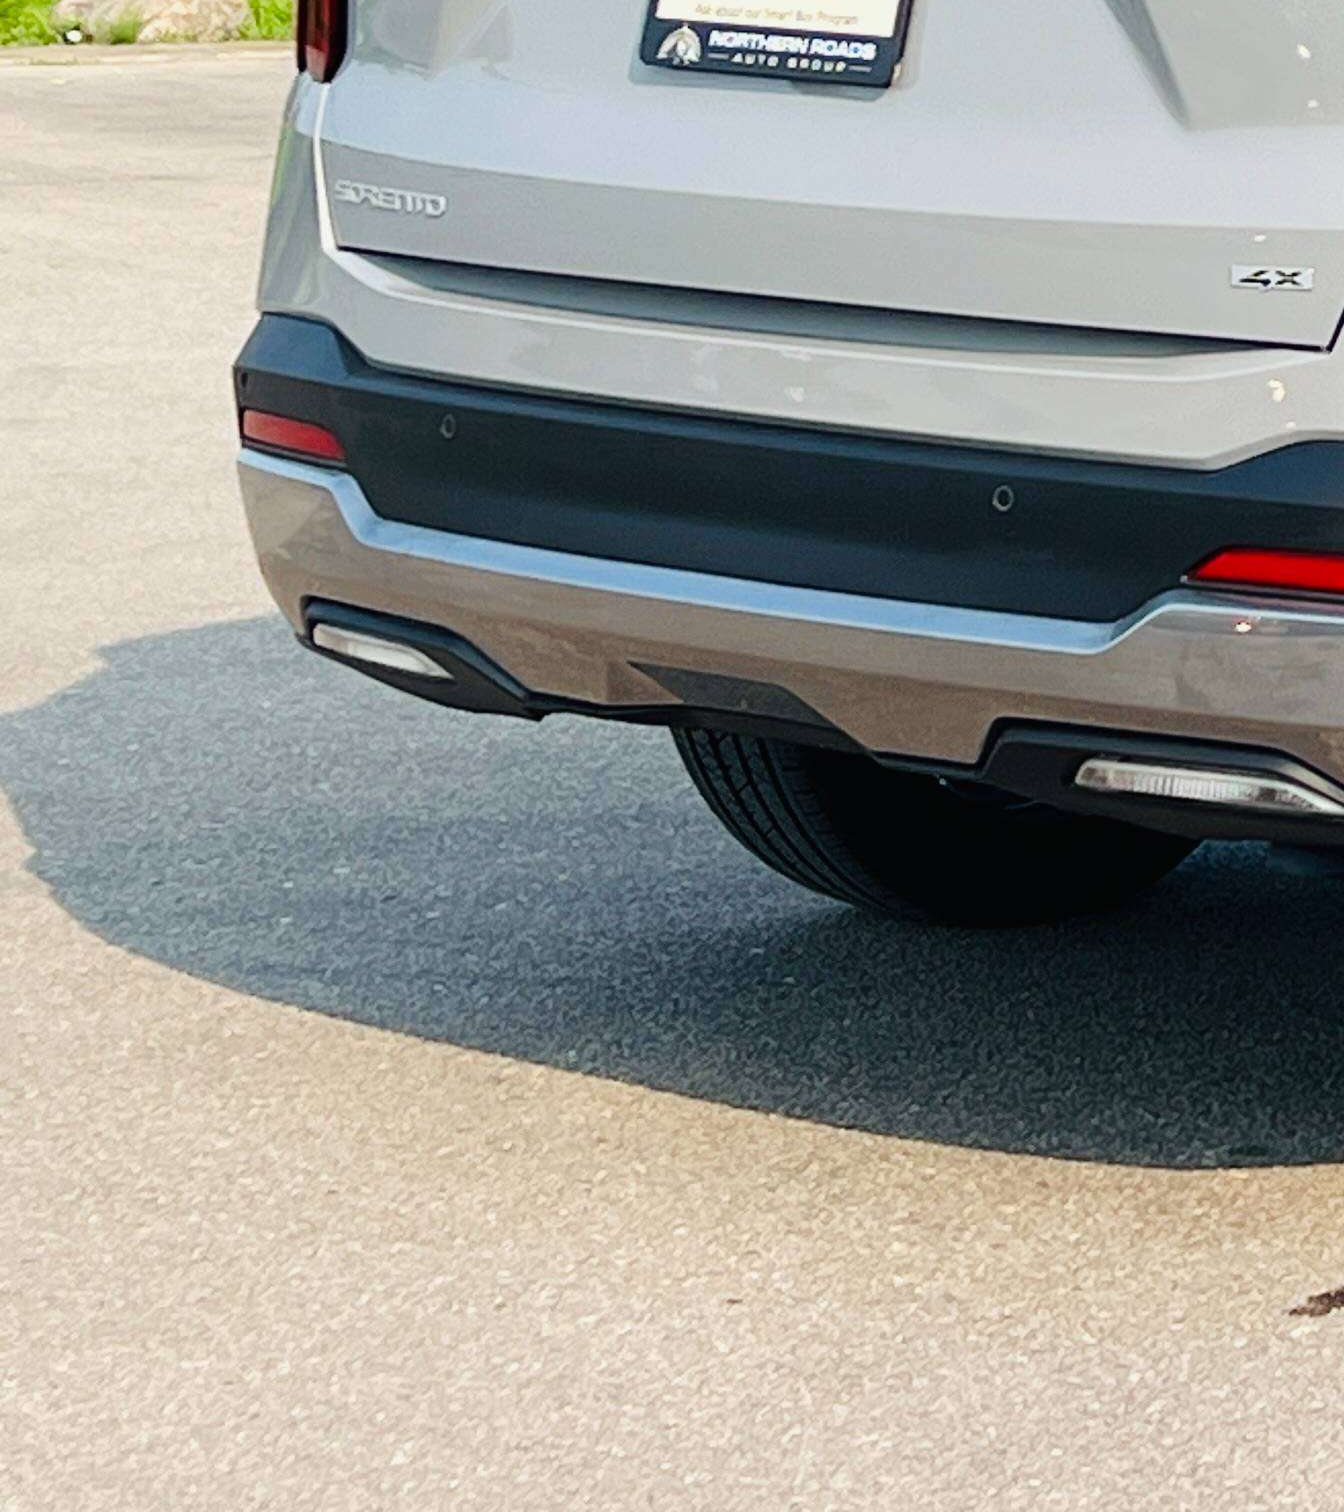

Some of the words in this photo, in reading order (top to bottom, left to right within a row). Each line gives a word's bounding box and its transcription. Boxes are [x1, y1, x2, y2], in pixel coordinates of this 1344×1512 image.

[708, 29, 810, 55] NORTHERN
[809, 37, 878, 61] ROADS
[731, 52, 780, 68] AUTO
[786, 56, 848, 73] GROUP
